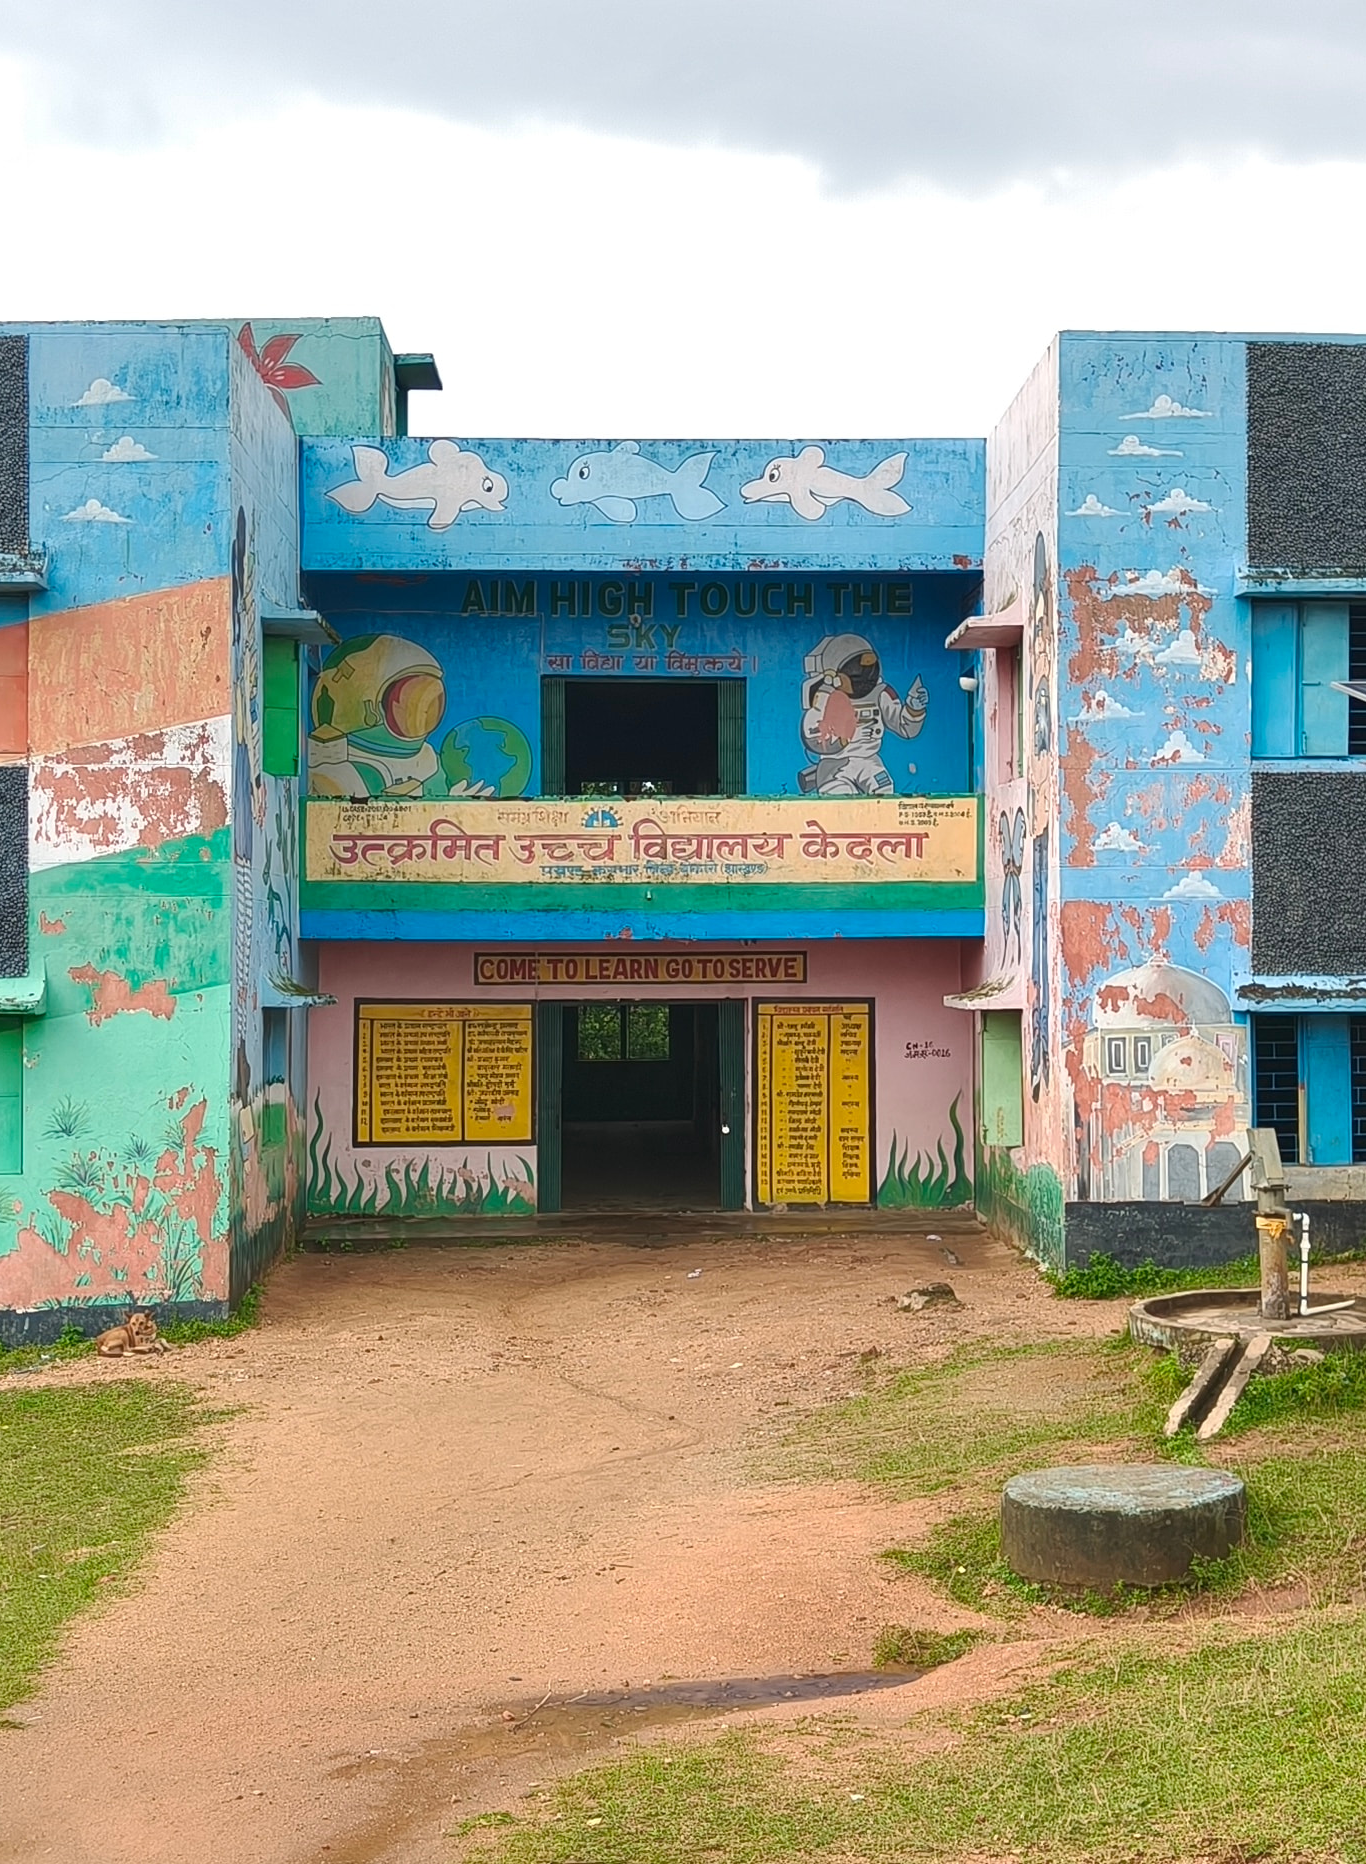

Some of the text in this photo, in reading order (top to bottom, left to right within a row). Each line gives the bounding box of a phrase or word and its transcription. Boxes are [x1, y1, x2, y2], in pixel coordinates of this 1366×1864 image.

[461, 580, 913, 617] AIM HIGH TOUCH THE
[607, 623, 681, 650] SKY
[546, 654, 573, 671] सा
[580, 651, 623, 672] विद्या
[633, 655, 656, 671] या
[329, 816, 931, 866] उत्क्रमित उच्च विद्यालय केदला
[479, 957, 798, 980] COME TO LEARN GO TO SERVE
